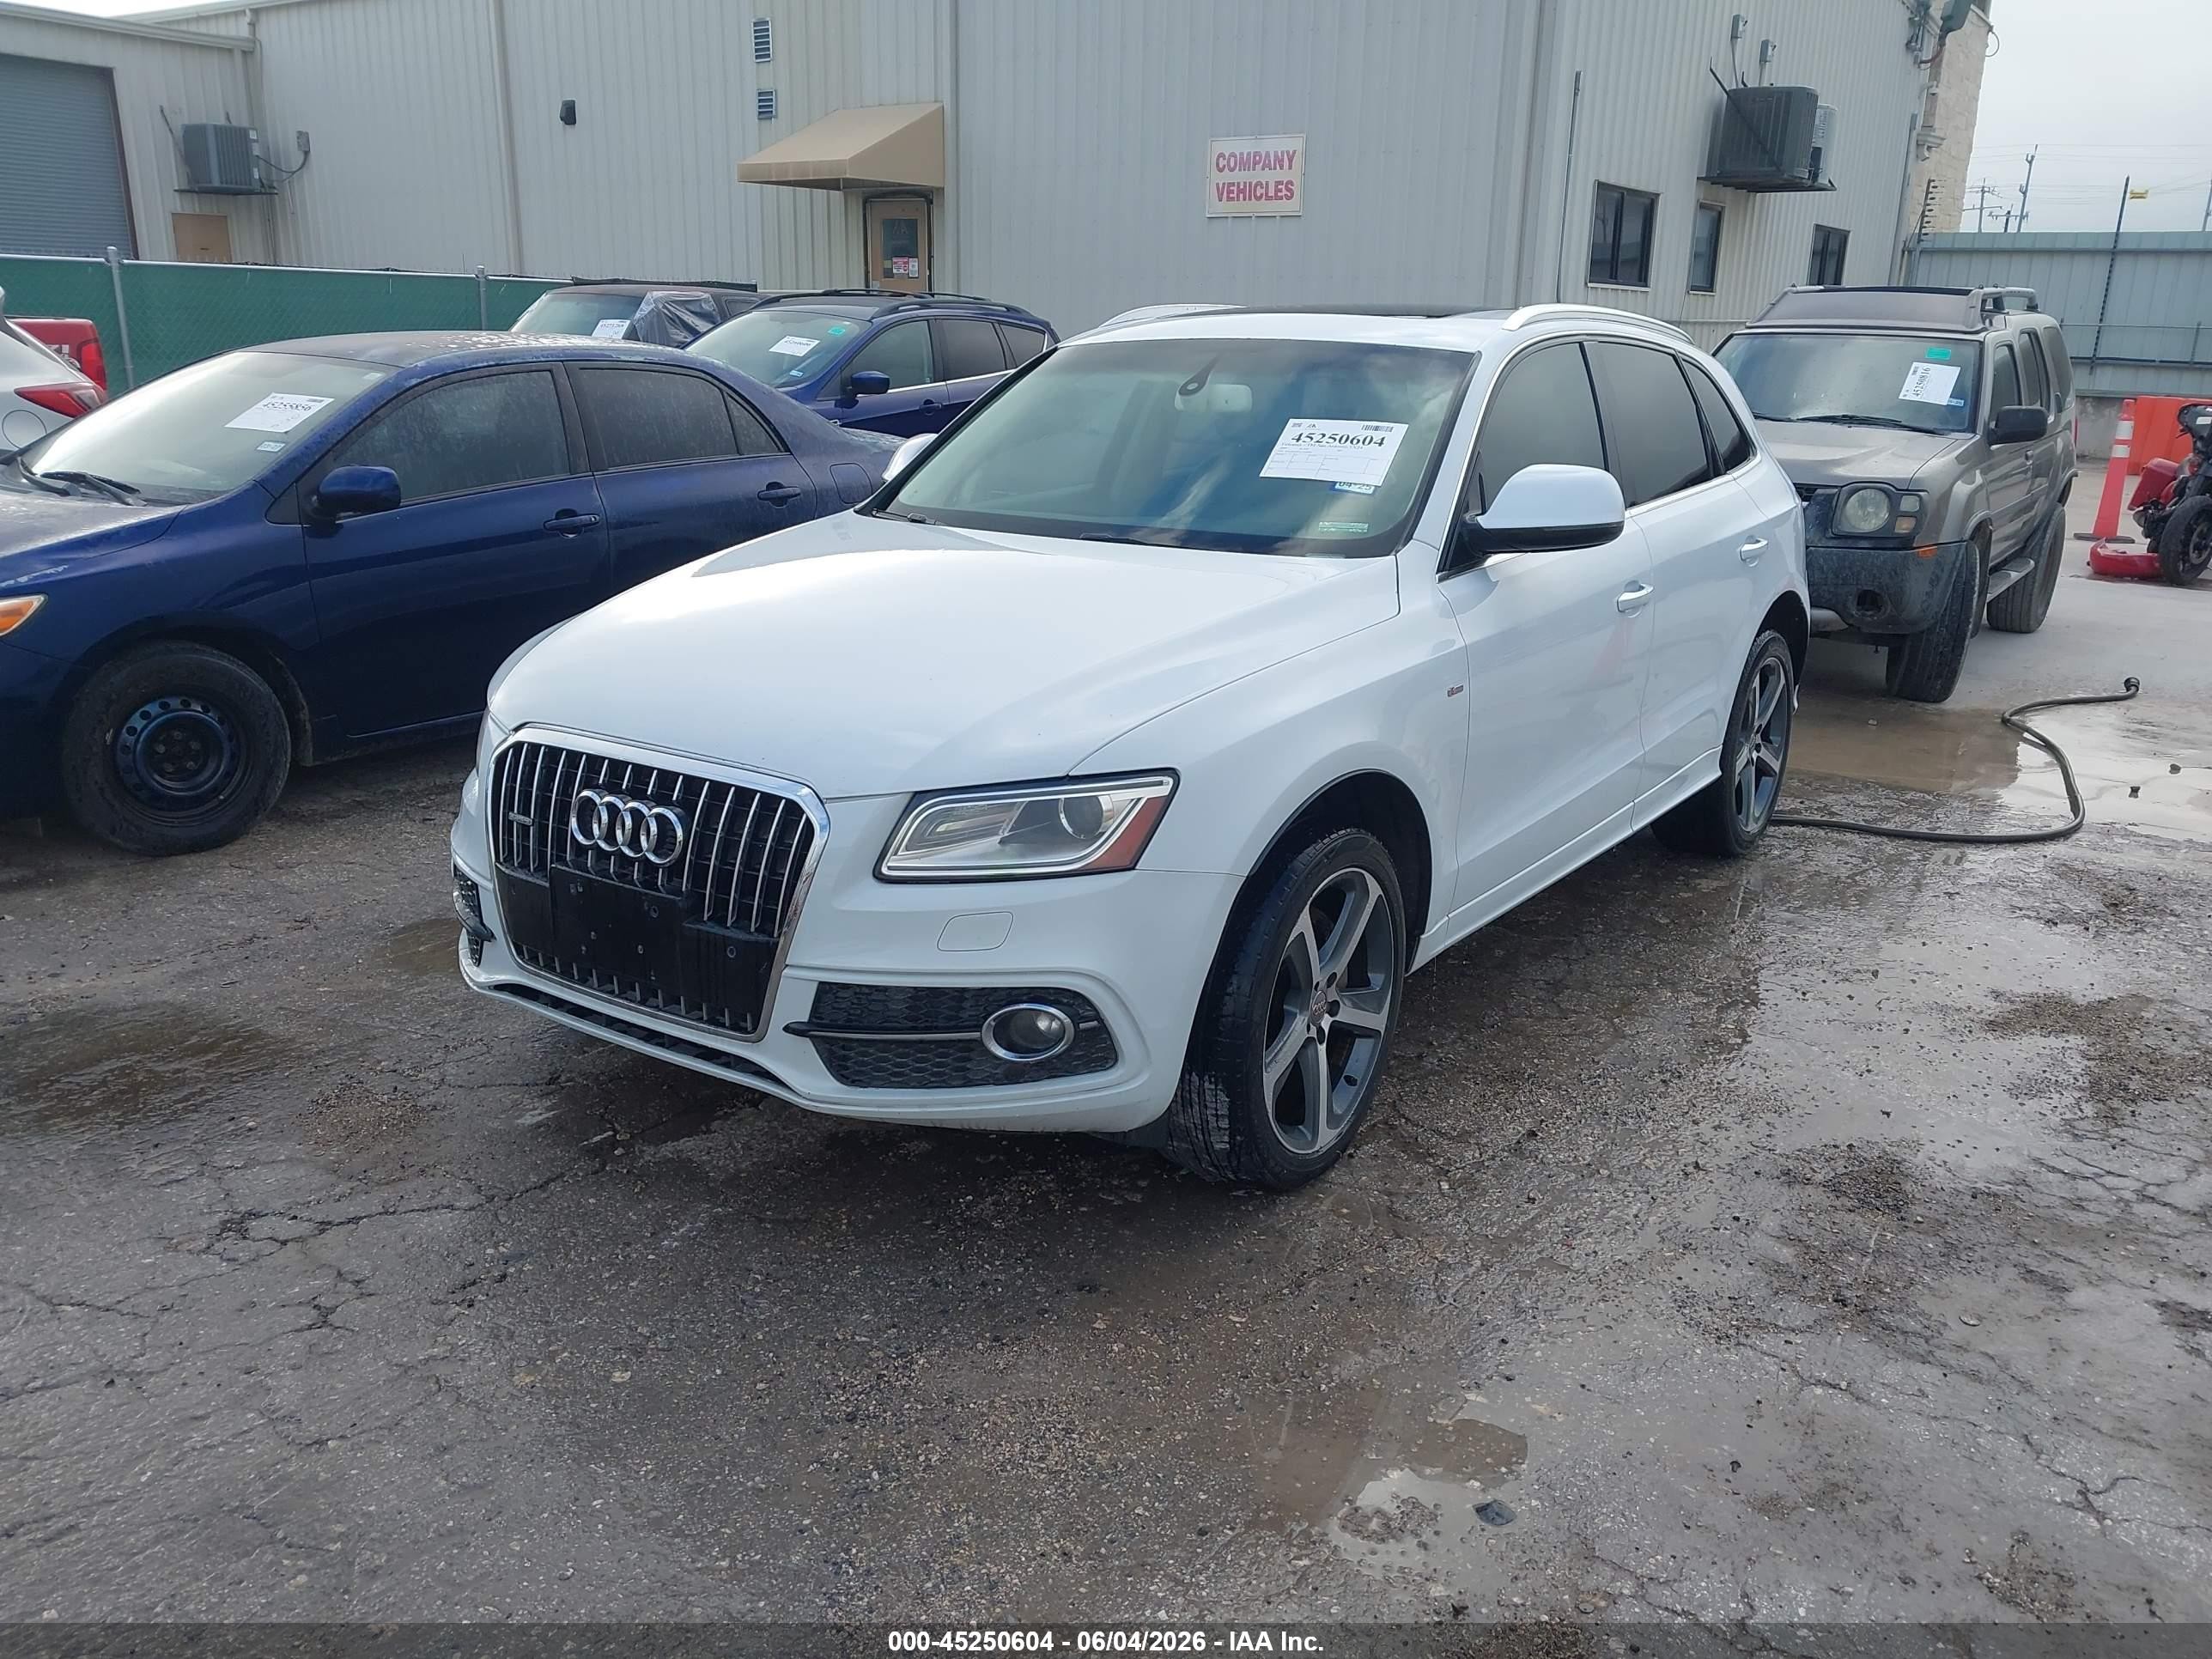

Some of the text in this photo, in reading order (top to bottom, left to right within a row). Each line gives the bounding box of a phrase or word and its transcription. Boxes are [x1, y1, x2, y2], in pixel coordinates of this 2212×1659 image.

[1215, 149, 1297, 173] COMPANY
[1215, 179, 1295, 203] VEHICLES
[1291, 432, 1388, 447] 45250604
